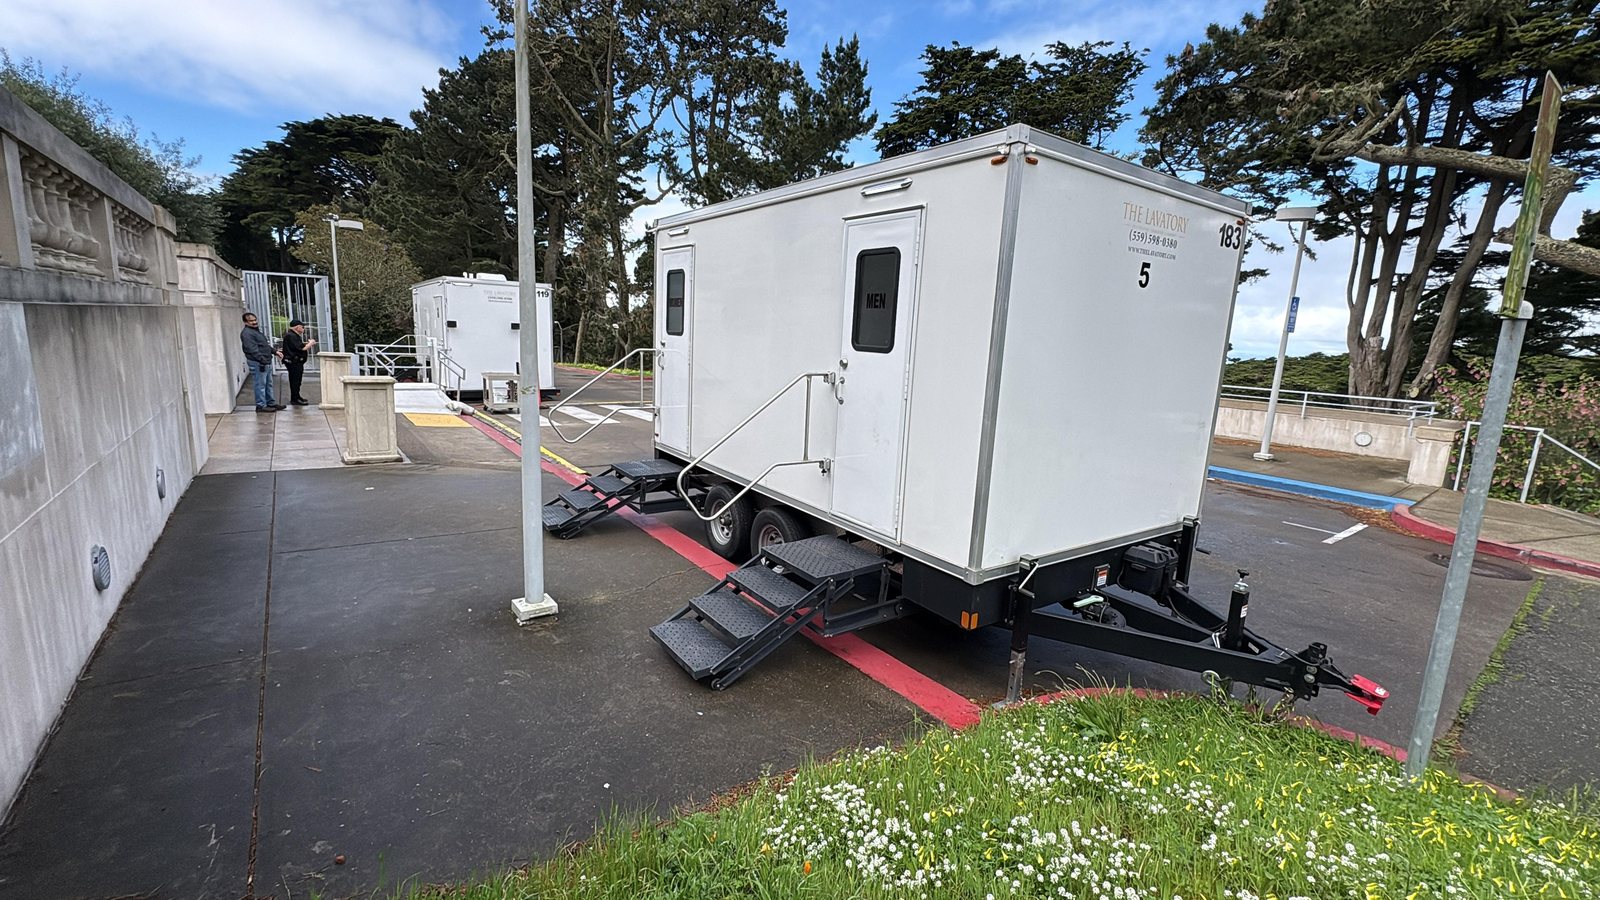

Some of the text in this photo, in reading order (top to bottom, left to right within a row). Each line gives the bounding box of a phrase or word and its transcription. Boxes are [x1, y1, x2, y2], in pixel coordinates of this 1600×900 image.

[1123, 201, 1143, 223] THE
[1145, 207, 1190, 234] LAVATORY
[1219, 222, 1241, 250] 183
[1138, 261, 1151, 288] 5
[536, 290, 549, 298] 119
[866, 293, 886, 309] MEN
